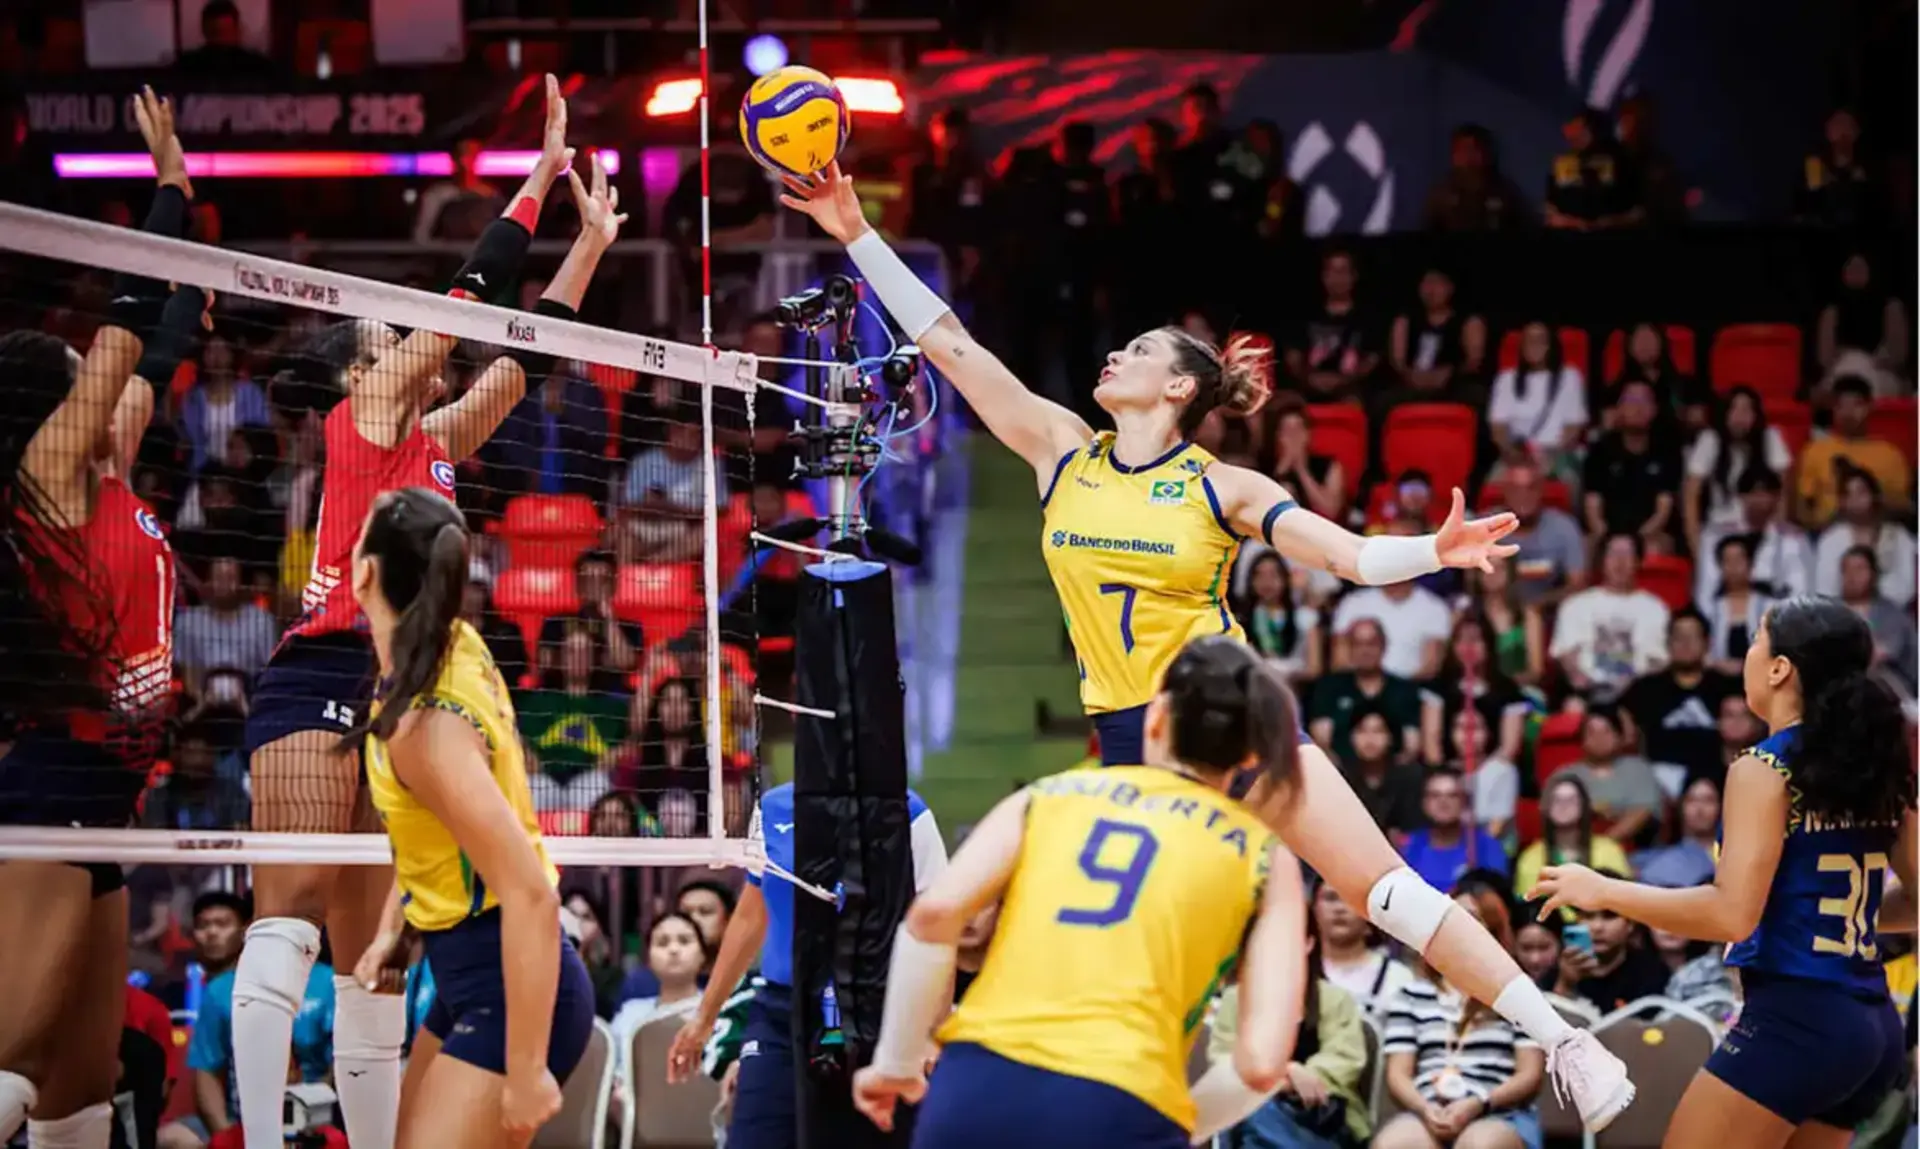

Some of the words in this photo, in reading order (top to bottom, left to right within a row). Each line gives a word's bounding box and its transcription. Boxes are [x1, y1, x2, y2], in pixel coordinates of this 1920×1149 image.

[1069, 533, 1112, 549] BANCO
[1131, 539, 1175, 555] BRASIL
[1099, 583, 1137, 655] 7
[1056, 817, 1159, 927] 9
[1812, 852, 1889, 961] 30
